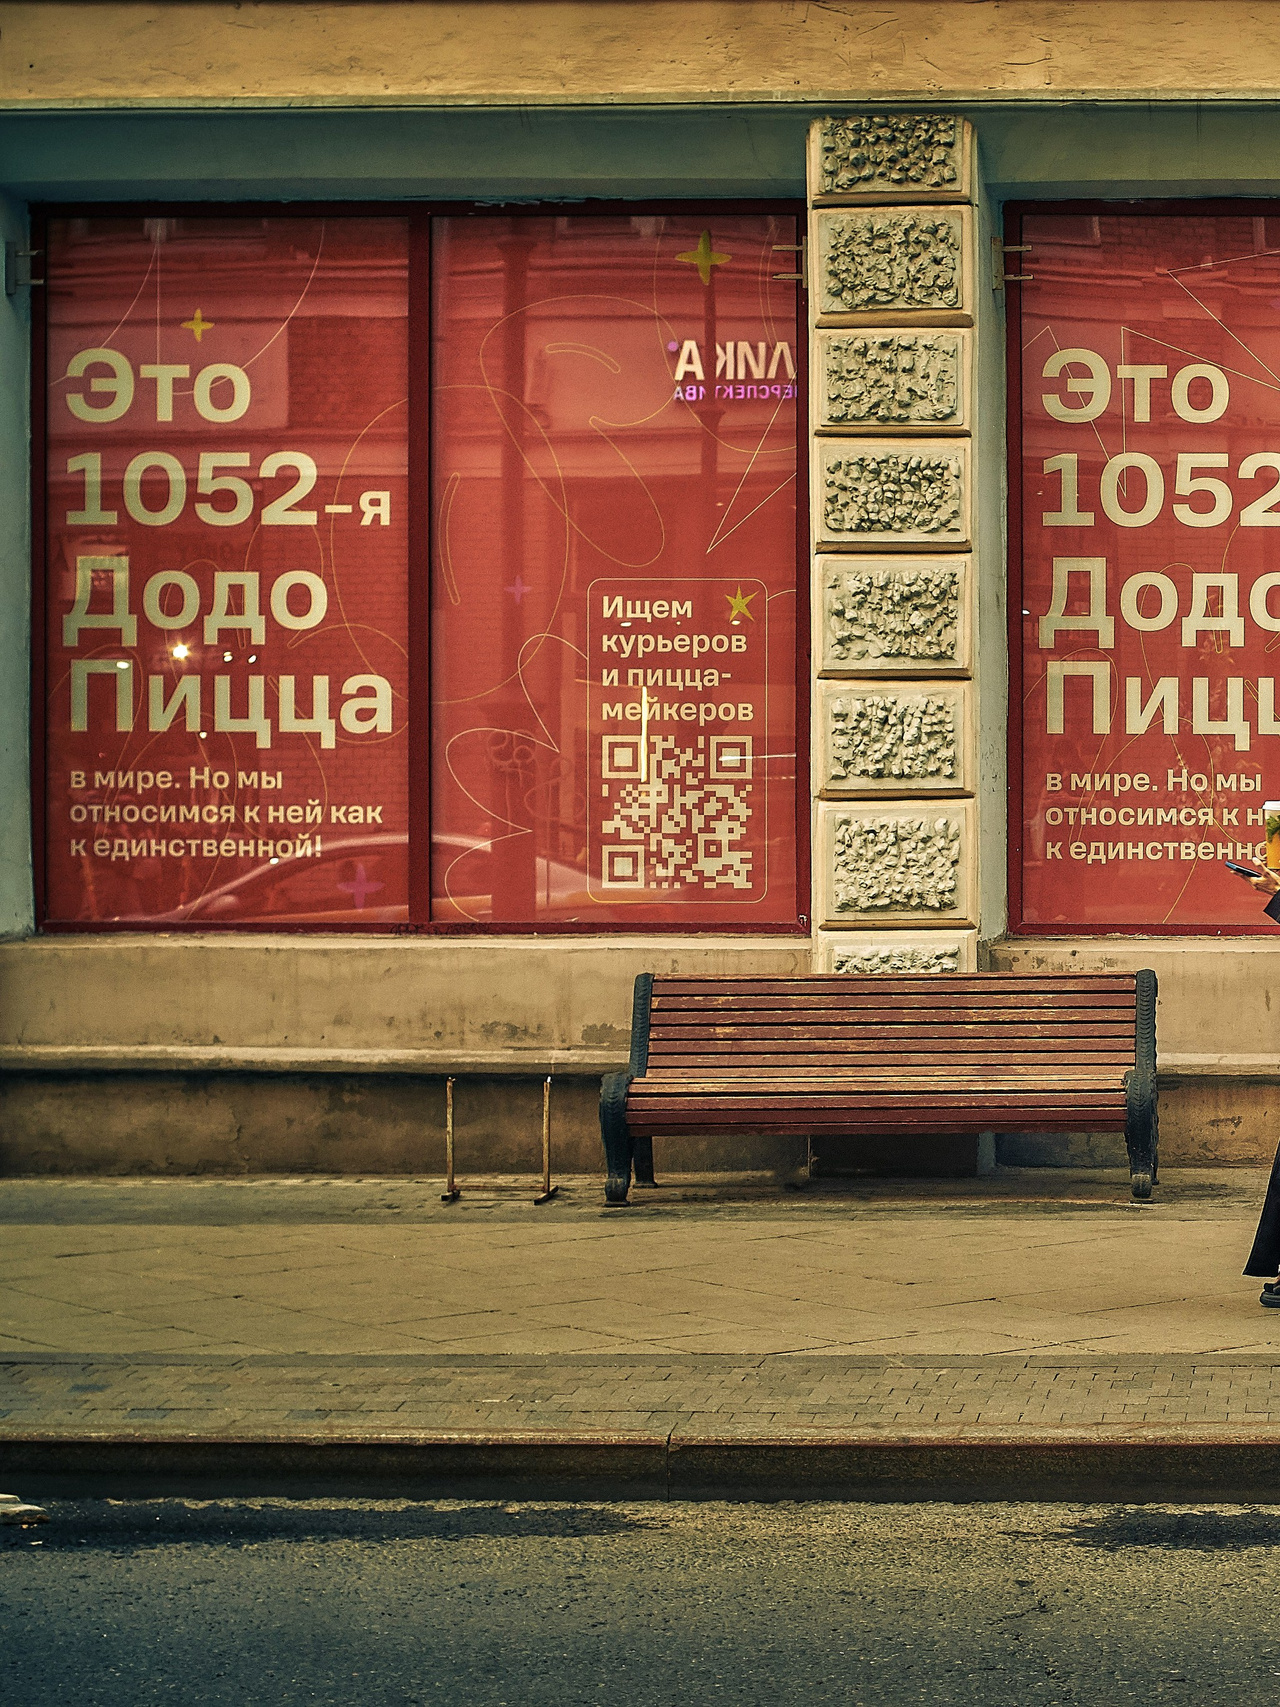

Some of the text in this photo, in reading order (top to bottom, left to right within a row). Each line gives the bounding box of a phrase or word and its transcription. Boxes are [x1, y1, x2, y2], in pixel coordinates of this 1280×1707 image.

[65, 347, 251, 424] Это
[1041, 348, 1230, 424] Это
[65, 451, 392, 527] 1052-я
[62, 556, 328, 648] Додо
[602, 595, 692, 623] Ищем
[602, 634, 748, 658] курьеров
[602, 668, 732, 691] и пицца-
[70, 659, 393, 749] Пицца
[602, 696, 754, 727] мейкеров
[70, 767, 283, 794] в мире. Но мы
[1046, 769, 1262, 797] в мире. Но мы
[70, 799, 383, 824] относимся к ней как
[1046, 807, 1214, 827] относимся
[1222, 807, 1239, 826] к
[70, 834, 322, 861] к единственной!
[1046, 842, 1063, 860] к
